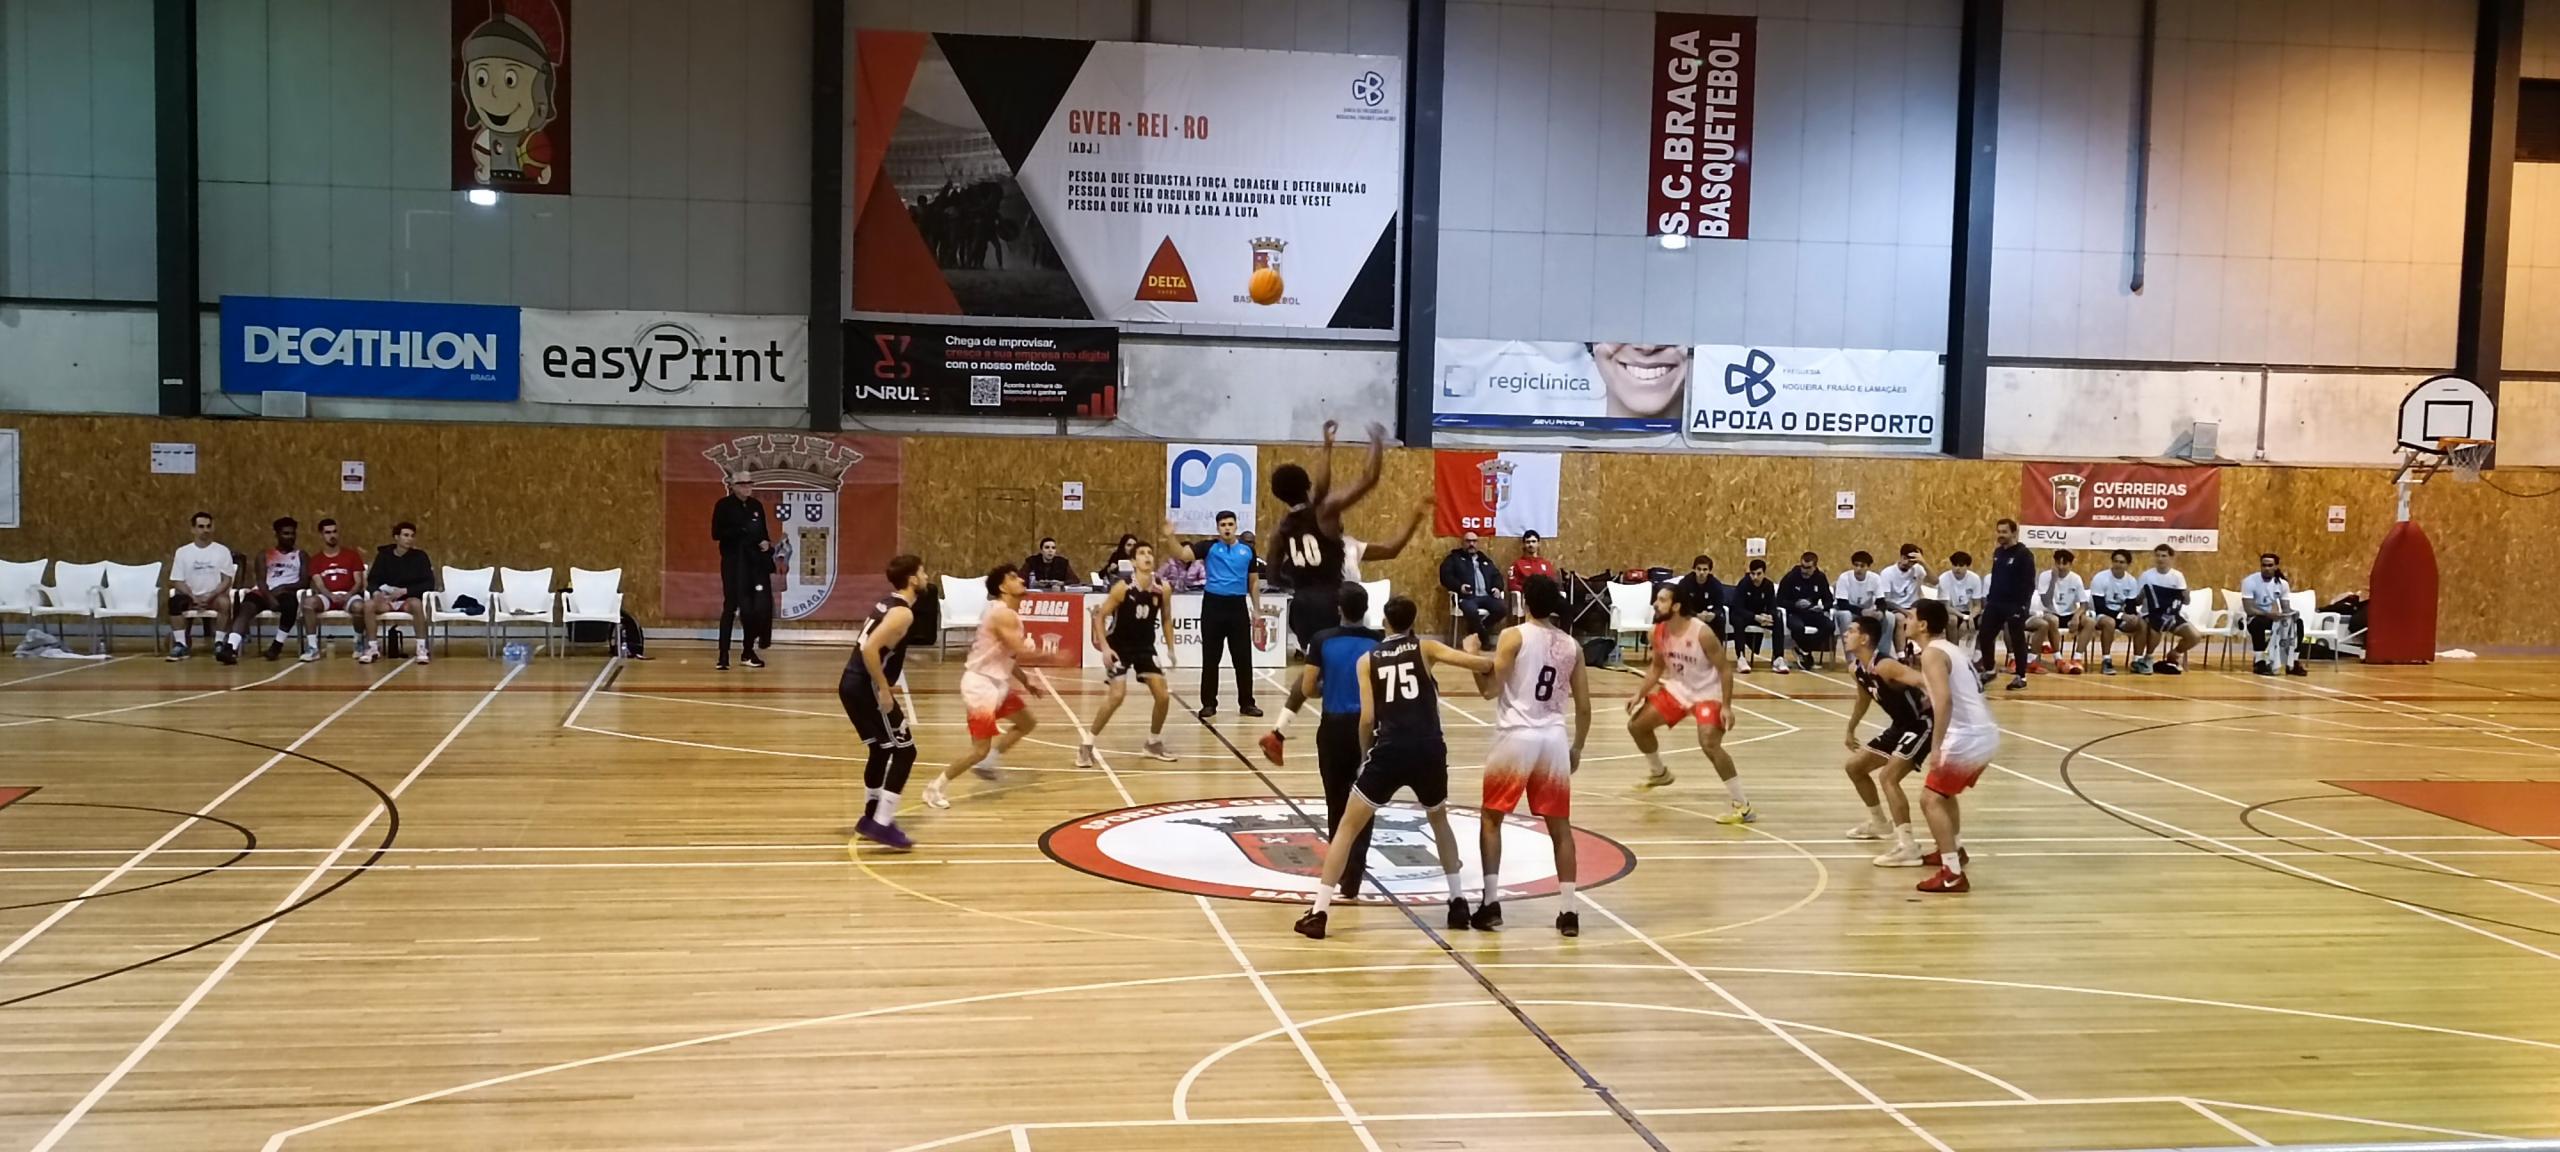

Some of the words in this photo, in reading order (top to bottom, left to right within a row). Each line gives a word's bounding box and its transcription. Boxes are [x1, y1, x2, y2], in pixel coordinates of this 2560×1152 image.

[1069, 109, 1120, 136] GVER
[1137, 112, 1168, 138] REI
[1184, 114, 1209, 140] RO
[1658, 30, 1700, 235] S.C.BRAGA
[1698, 32, 1741, 238] BASQUETEBOL
[1068, 170, 1106, 183] PESSOA
[1111, 172, 1129, 184] QUE
[1134, 173, 1191, 187] DEMONSTRA
[1234, 178, 1279, 191] CORAGEM
[1284, 180, 1288, 191] E
[1293, 181, 1366, 194] DETERMINAÇÃO
[1068, 185, 1106, 197] PESSOA
[1111, 187, 1129, 198] QUE
[1134, 188, 1153, 199] TEM
[1158, 189, 1200, 201] ORGULHO
[1205, 191, 1217, 202] NA
[1222, 192, 1275, 205] ARMADURA
[1280, 194, 1297, 206] QUE
[1302, 196, 1332, 207] VESTE
[1068, 199, 1106, 212] PESSOA
[1111, 201, 1129, 213] QUE
[1134, 200, 1153, 214] NÃO
[1157, 203, 1180, 215] VIRA
[1185, 204, 1190, 215] A
[1195, 204, 1220, 216] CARA
[1224, 206, 1230, 216] A
[1235, 206, 1259, 218] LUTA
[1148, 275, 1187, 288] DELTA
[244, 325, 497, 370] DECATHLON
[945, 335, 980, 348] Chega
[983, 336, 996, 346] de
[1000, 337, 1057, 349] improvisar,
[543, 334, 785, 392] easyPrint
[945, 361, 968, 369] com
[980, 362, 1012, 370] nosso
[1015, 360, 1057, 371] método.
[470, 374, 496, 382] BRAGA
[1489, 372, 1591, 394] regiclinica
[1864, 384, 1907, 394] LAMAÇÃES
[1693, 410, 1773, 430] APOIA
[1781, 411, 1797, 431] O
[1805, 412, 1934, 434] DESPORTO
[2093, 482, 2187, 496] GVERREIRAS
[2093, 497, 2114, 508] DO
[2117, 497, 2168, 510] MINHO
[1462, 516, 1480, 528] SC
[2027, 529, 2067, 540] SEVU
[2167, 534, 2210, 544] meltino
[792, 588, 826, 614] BRAGA
[1018, 600, 1034, 615] SC
[1034, 600, 1069, 616] BRAGA
[1378, 662, 1419, 702] 75
[1534, 665, 1556, 702] 8
[1080, 802, 1220, 830] SPORTING
